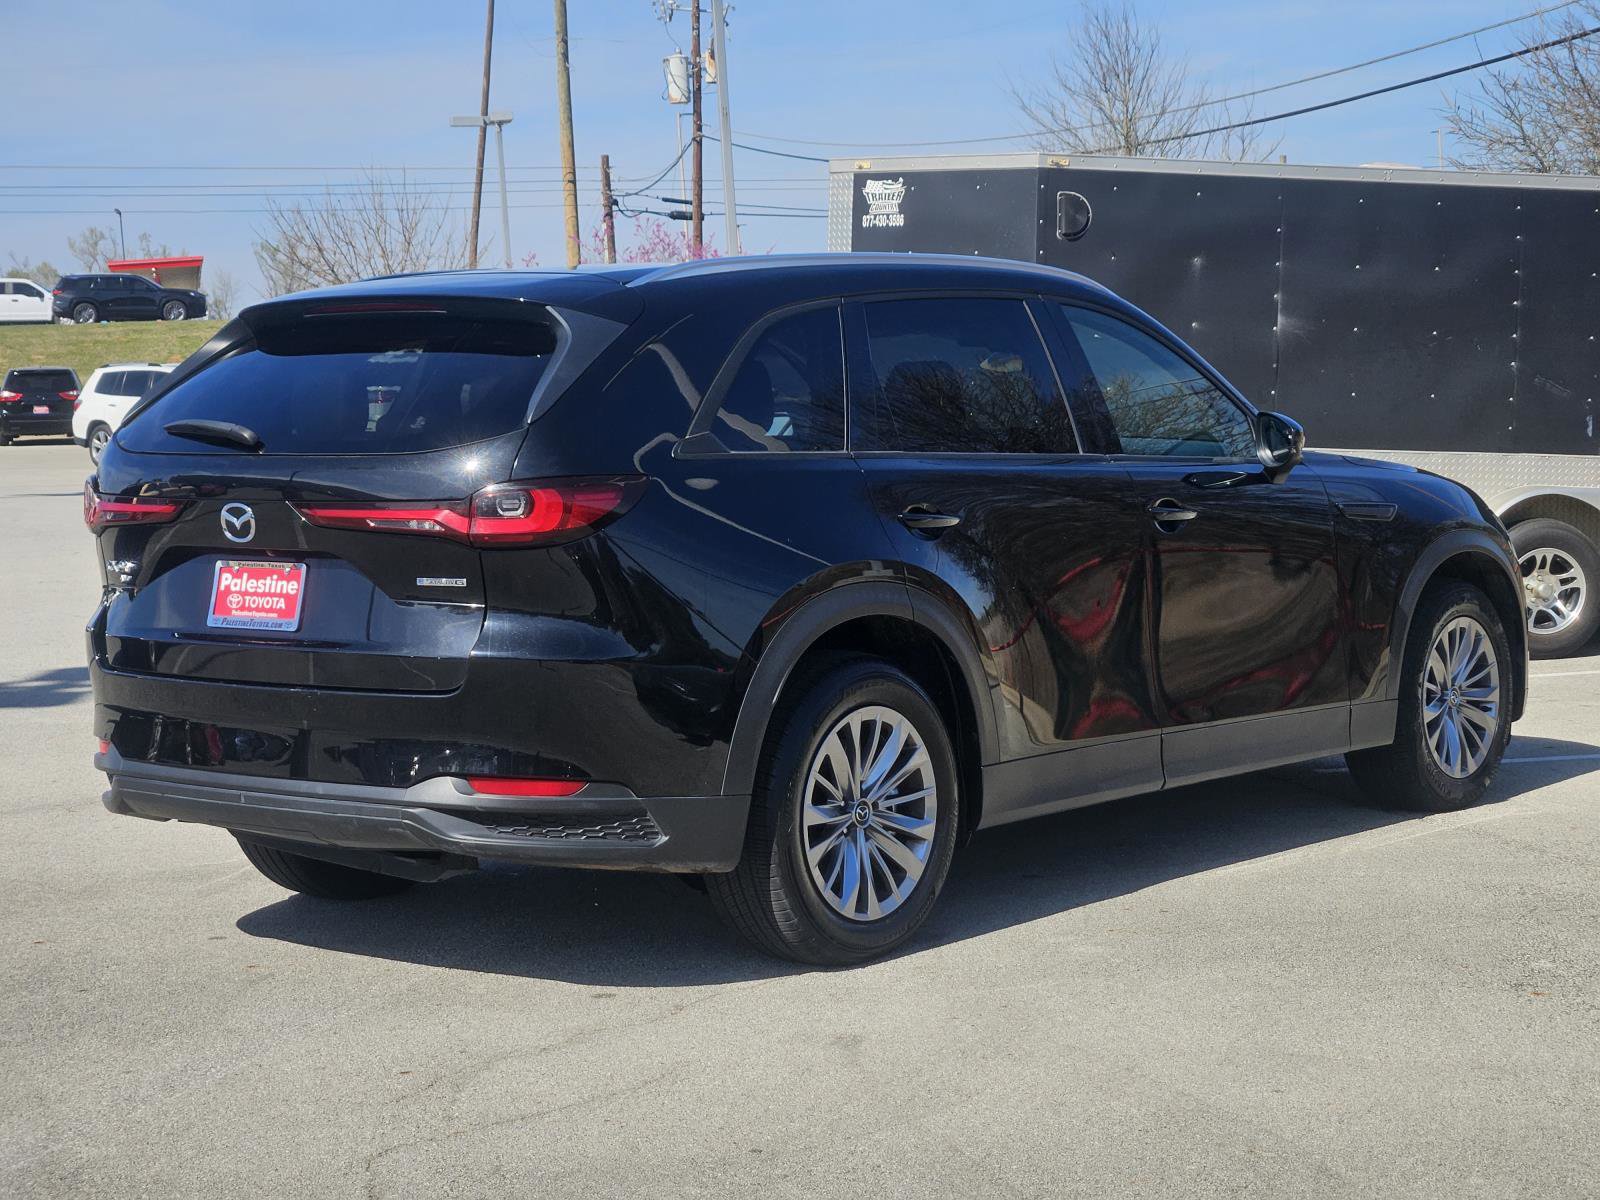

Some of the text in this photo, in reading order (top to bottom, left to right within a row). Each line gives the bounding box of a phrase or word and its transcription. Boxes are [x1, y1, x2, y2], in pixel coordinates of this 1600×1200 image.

[865, 190, 904, 203] TRAILER
[220, 572, 299, 595] Palestine
[244, 595, 286, 610] TOYOTA
